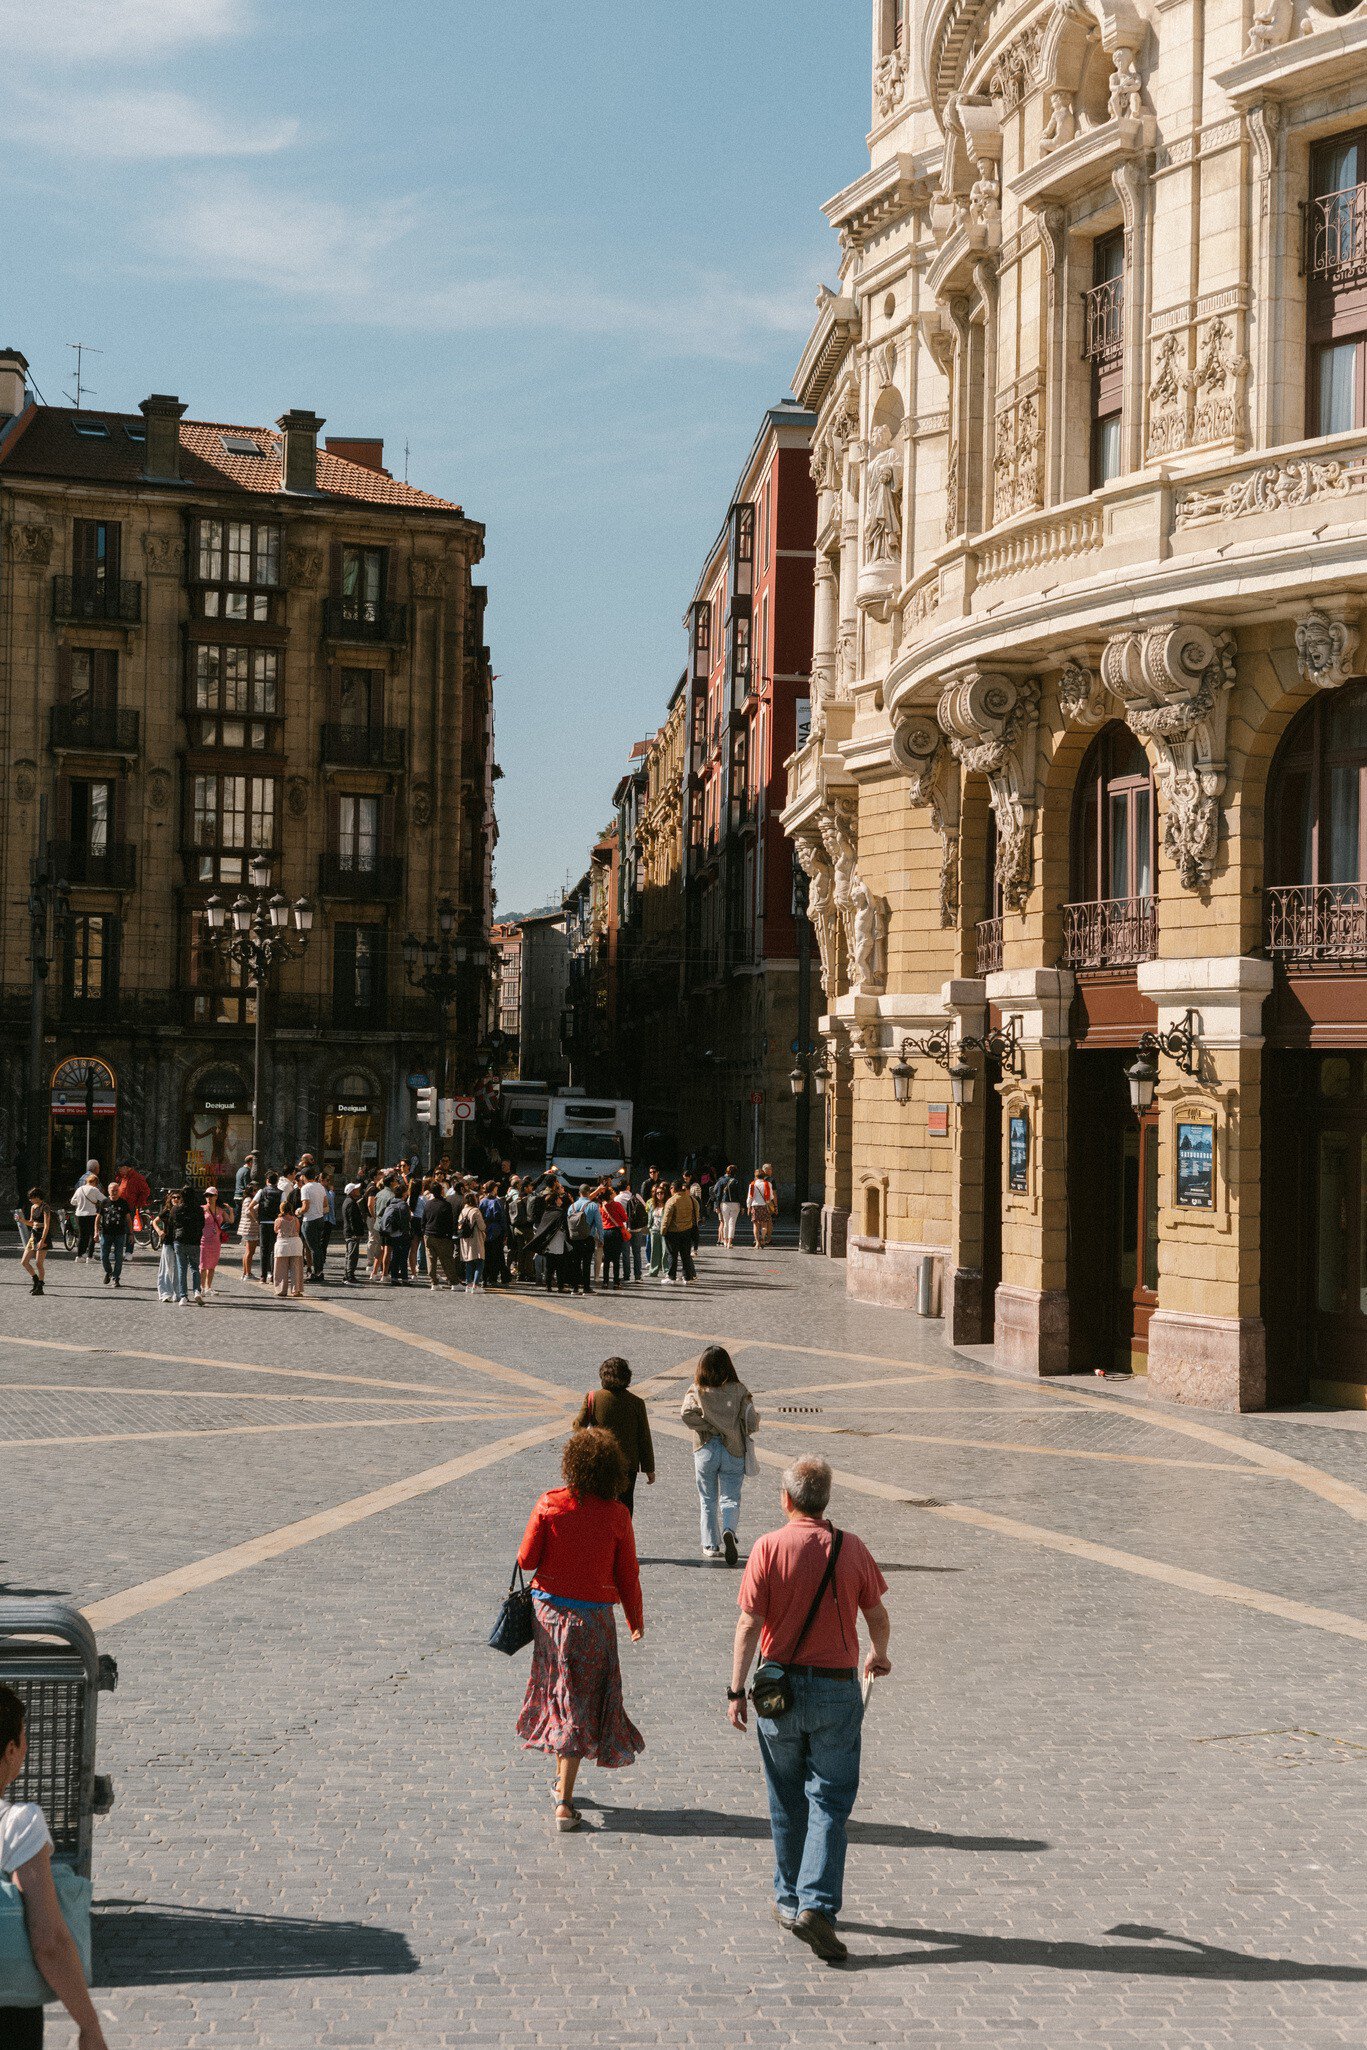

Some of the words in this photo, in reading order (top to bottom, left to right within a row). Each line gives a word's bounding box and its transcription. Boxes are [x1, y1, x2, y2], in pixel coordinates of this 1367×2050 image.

[799, 721, 811, 751] NA
[205, 1102, 235, 1110] Desigual
[186, 1150, 204, 1162] THE
[186, 1163, 230, 1175] SUMME
